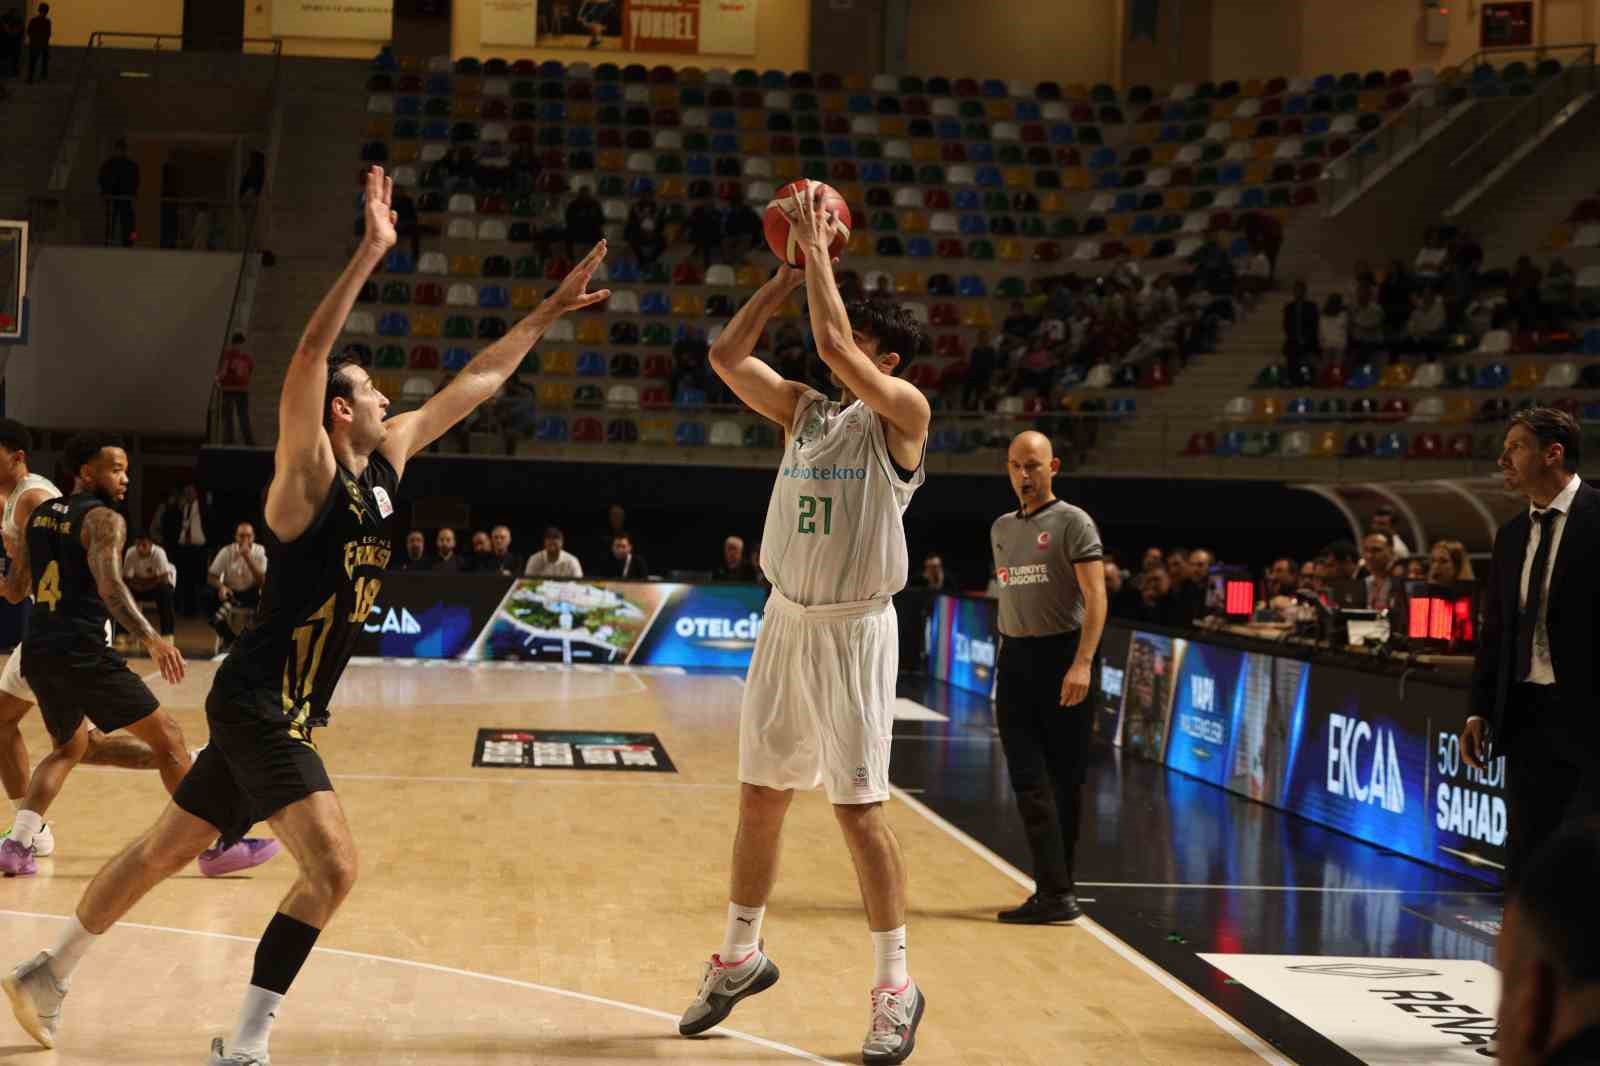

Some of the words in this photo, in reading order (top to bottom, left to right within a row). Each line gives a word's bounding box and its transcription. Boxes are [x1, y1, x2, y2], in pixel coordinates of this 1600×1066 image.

[798, 495, 832, 535] 21
[36, 559, 62, 612] 4
[1438, 731, 1460, 777] 50
[1436, 782, 1508, 847] SAHAD
[1368, 989, 1500, 1060] RENA
